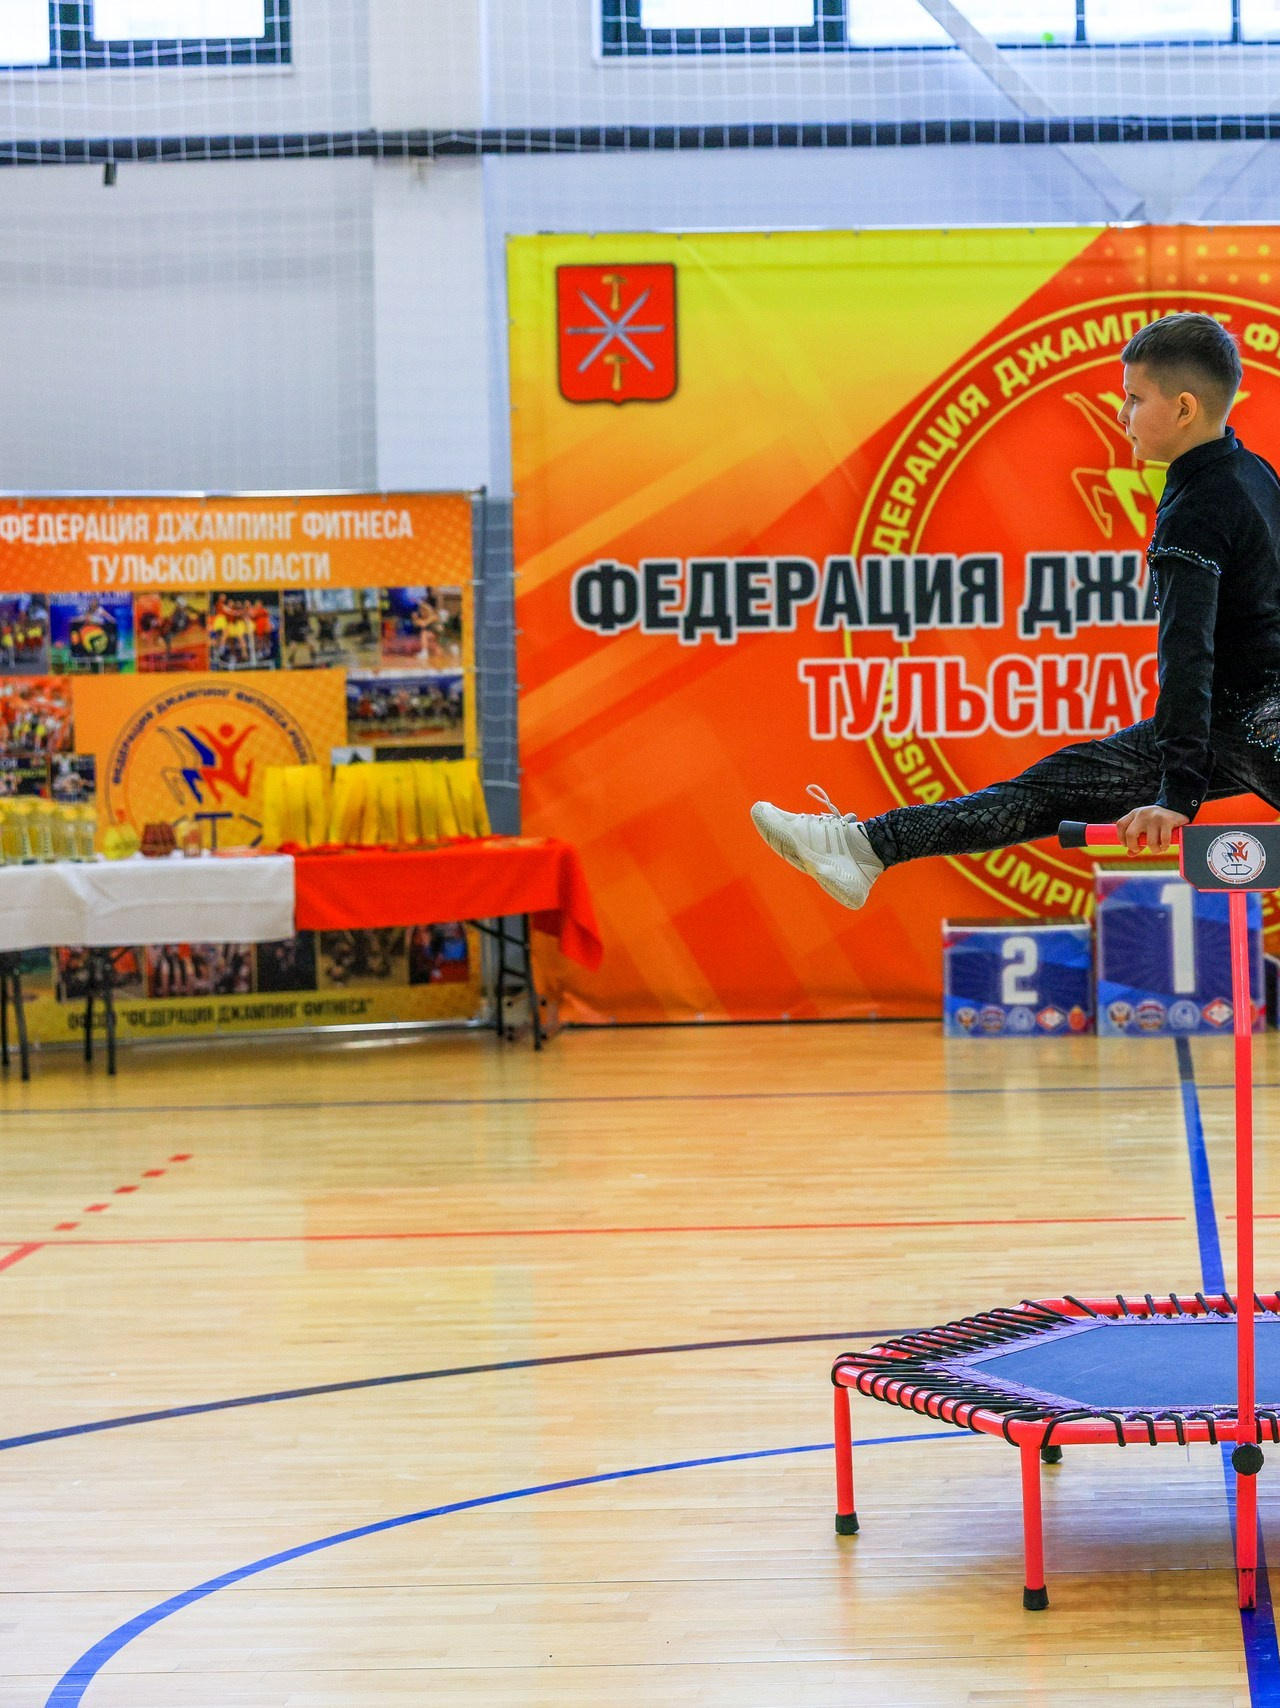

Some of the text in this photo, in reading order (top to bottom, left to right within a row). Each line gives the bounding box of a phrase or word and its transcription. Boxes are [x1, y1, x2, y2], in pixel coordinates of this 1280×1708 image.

[0, 509, 414, 545] ФЕДЕРАЦИЯ ДЖАМПИНГ ФИТНЕСА
[89, 549, 331, 585] ТУЛЬСКОЙ ОБЛАСТИ
[574, 555, 1002, 644] ФЕДЕРАЦИЯ
[1002, 936, 1039, 1005] 2
[1161, 883, 1196, 995] 1
